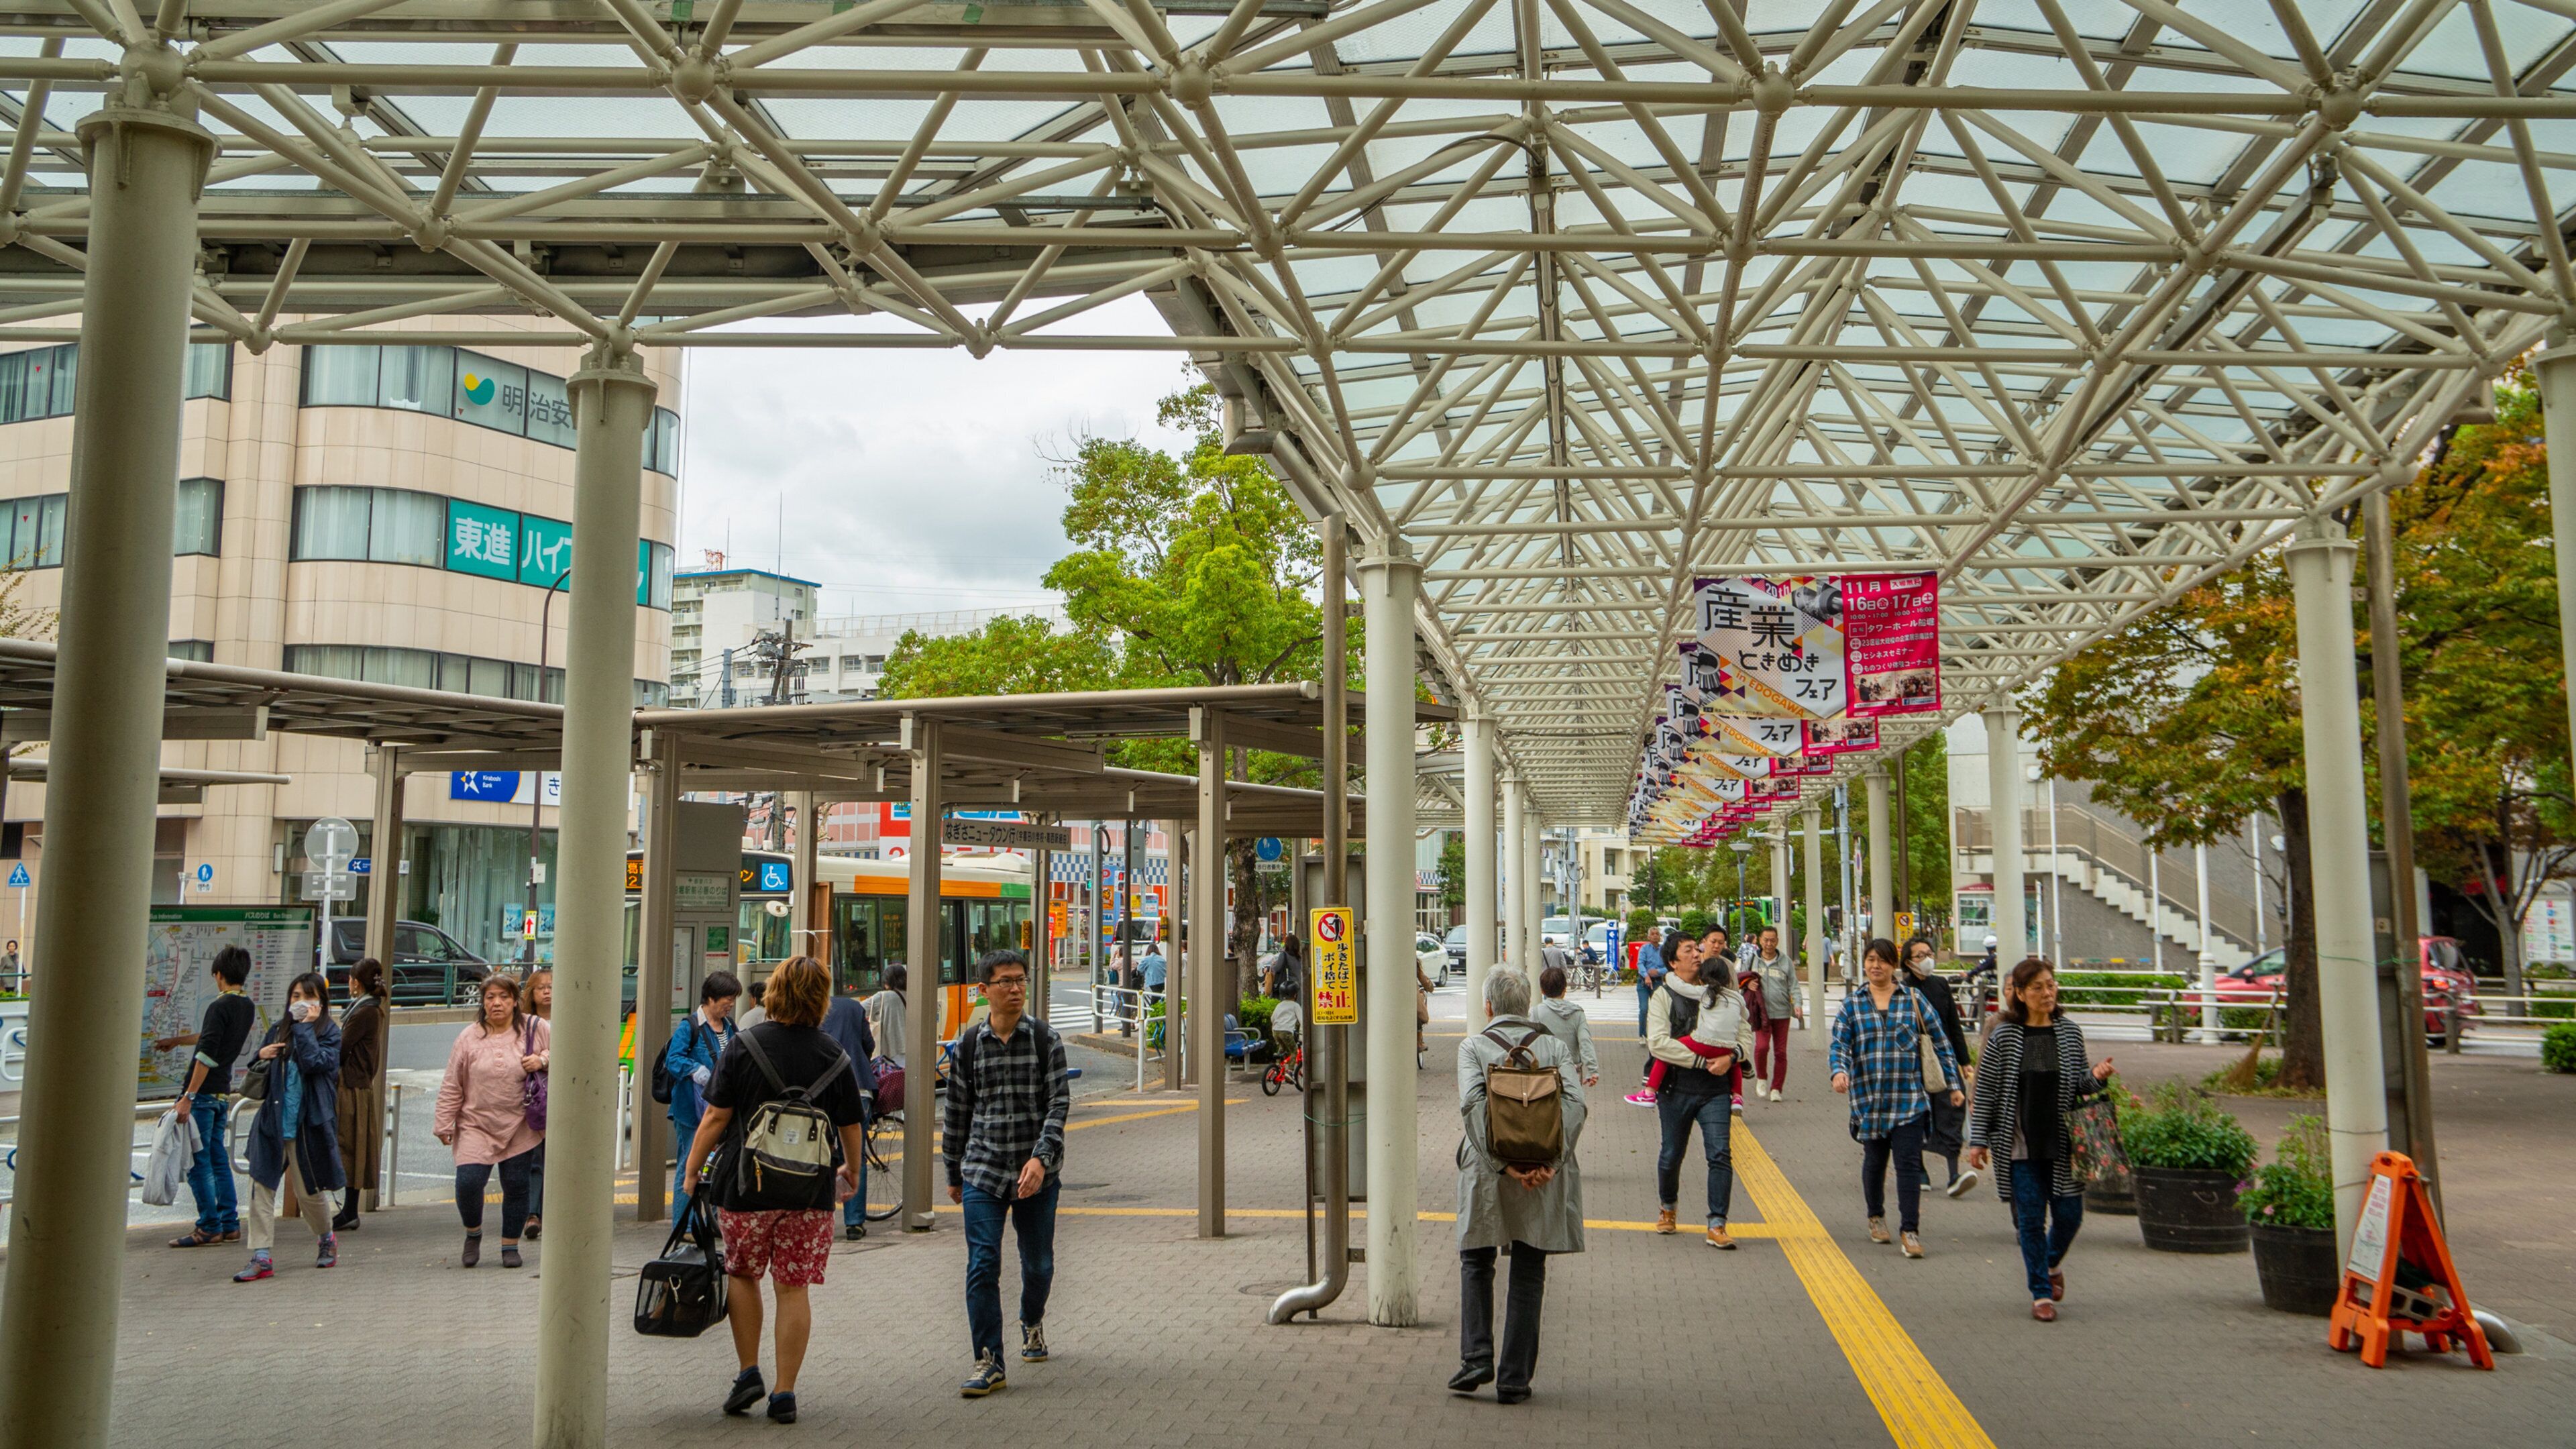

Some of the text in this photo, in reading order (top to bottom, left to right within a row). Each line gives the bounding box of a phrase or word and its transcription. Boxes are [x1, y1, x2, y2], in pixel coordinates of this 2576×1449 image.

[1765, 582, 1791, 598] 20th
[1705, 588, 1794, 647] 産業
[1738, 649, 1819, 672] ときめき
[1735, 670, 1805, 718] in EDOGAWA
[1795, 678, 1837, 701] フェア
[1723, 727, 1769, 757] EDOGAWA
[1760, 724, 1794, 742] フェア
[549, 777, 560, 796] き
[1338, 943, 1349, 989] 歩きたばこ
[1318, 991, 1351, 1009] 禁止
